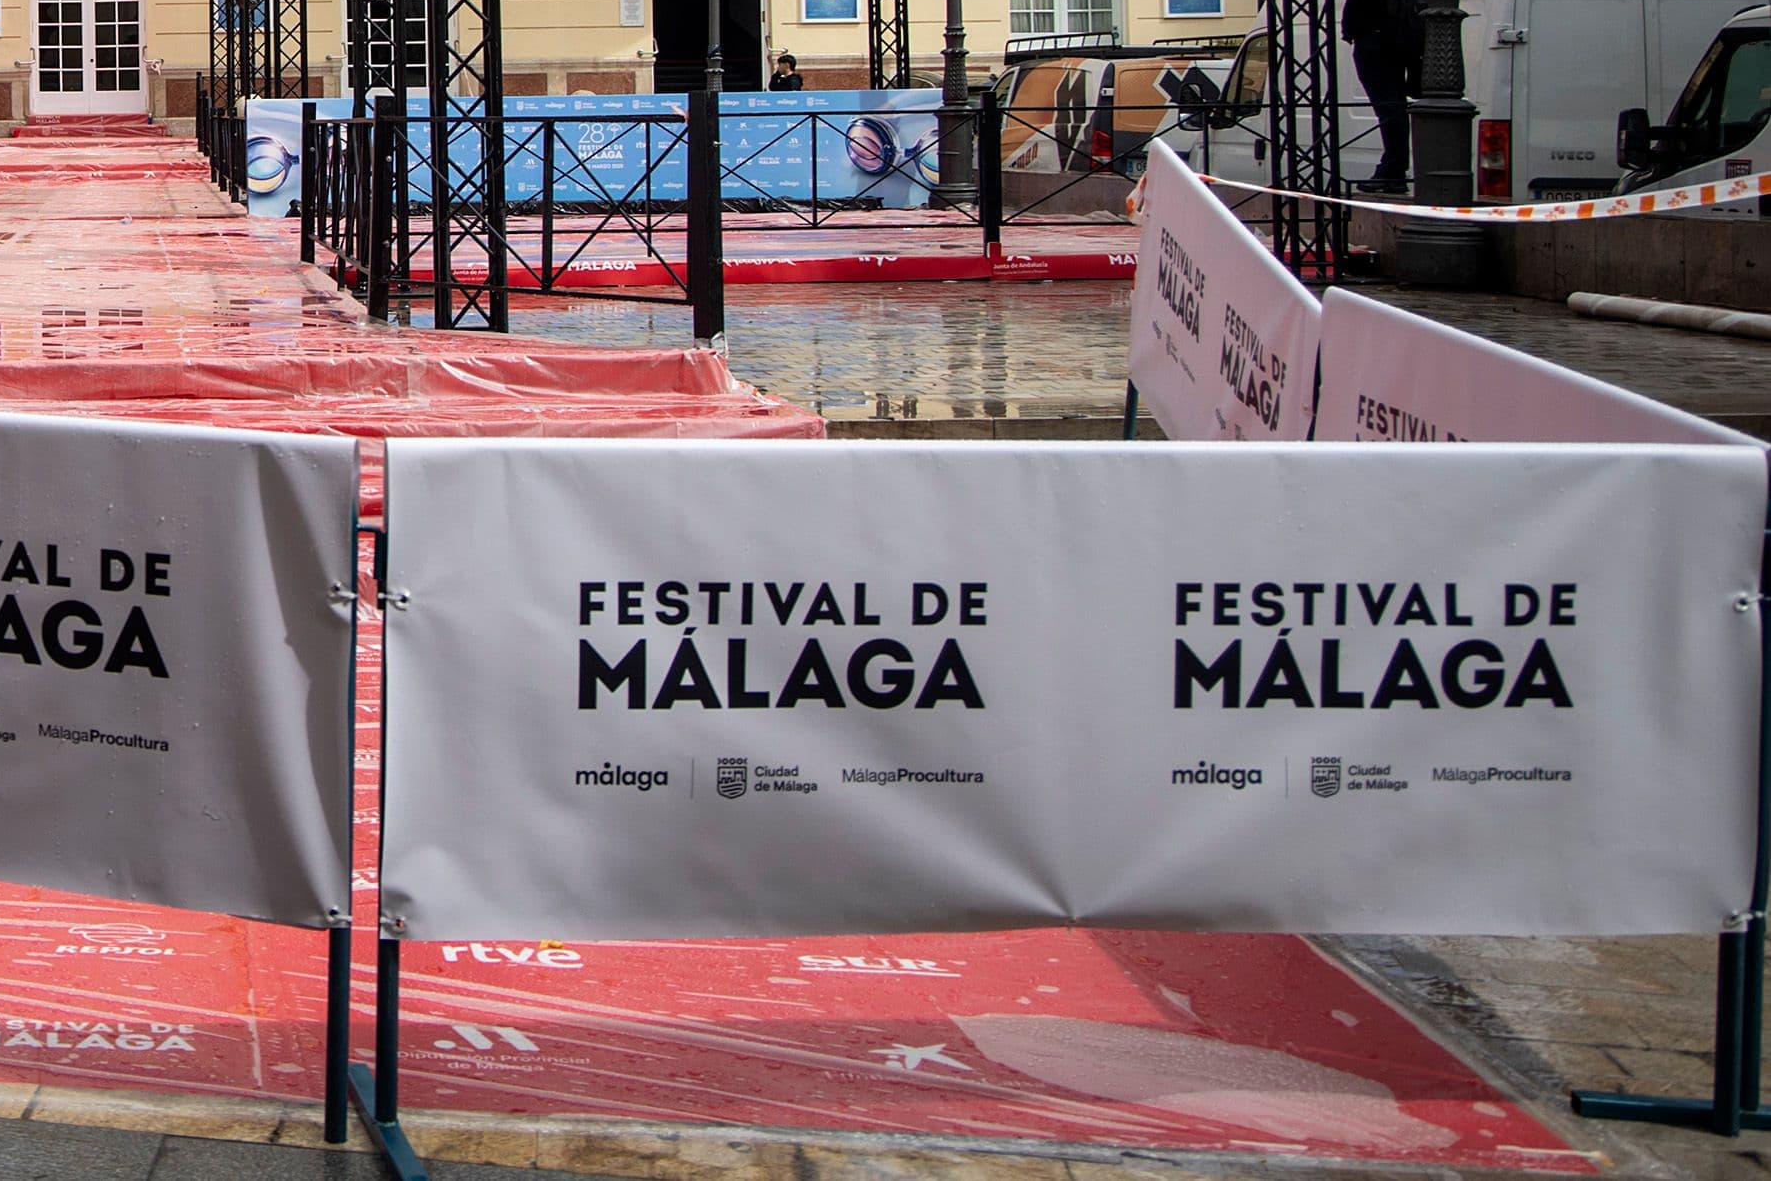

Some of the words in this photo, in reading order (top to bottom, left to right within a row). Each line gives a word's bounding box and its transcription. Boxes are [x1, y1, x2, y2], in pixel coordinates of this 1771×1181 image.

[578, 123, 605, 144] 28
[1550, 150, 1595, 160] IVECO
[1160, 227, 1193, 285] FESTIVAL
[1194, 267, 1206, 299] DE
[1157, 254, 1200, 344] MÁLAGA
[1225, 303, 1266, 373] FESTIVAL
[1271, 353, 1287, 389] DE
[1220, 334, 1281, 432] MÁLAGA
[101, 549, 170, 596] DE
[580, 581, 880, 626] FESTIVAL
[912, 583, 987, 626] DE
[1176, 583, 1472, 626] FESTIVAL
[1505, 584, 1576, 626] DE
[579, 627, 984, 709] MÁLAGA
[1175, 629, 1573, 709] MÁLAGA
[39, 723, 169, 752] MálagaProcultura
[755, 766, 799, 778] Ciudad
[843, 769, 984, 786] MálagaProcultura
[1348, 765, 1391, 776] Ciudad
[1433, 767, 1571, 784] MálagaProcultura
[755, 781, 769, 791] de
[773, 779, 818, 795] Málaga
[1348, 781, 1362, 790] de
[1365, 779, 1408, 793] Málaga
[56, 944, 176, 955] REPSOL
[442, 943, 585, 969] rtve
[797, 955, 947, 971] SUR
[150, 1022, 196, 1034] DE
[500, 1054, 590, 1065] Provincial
